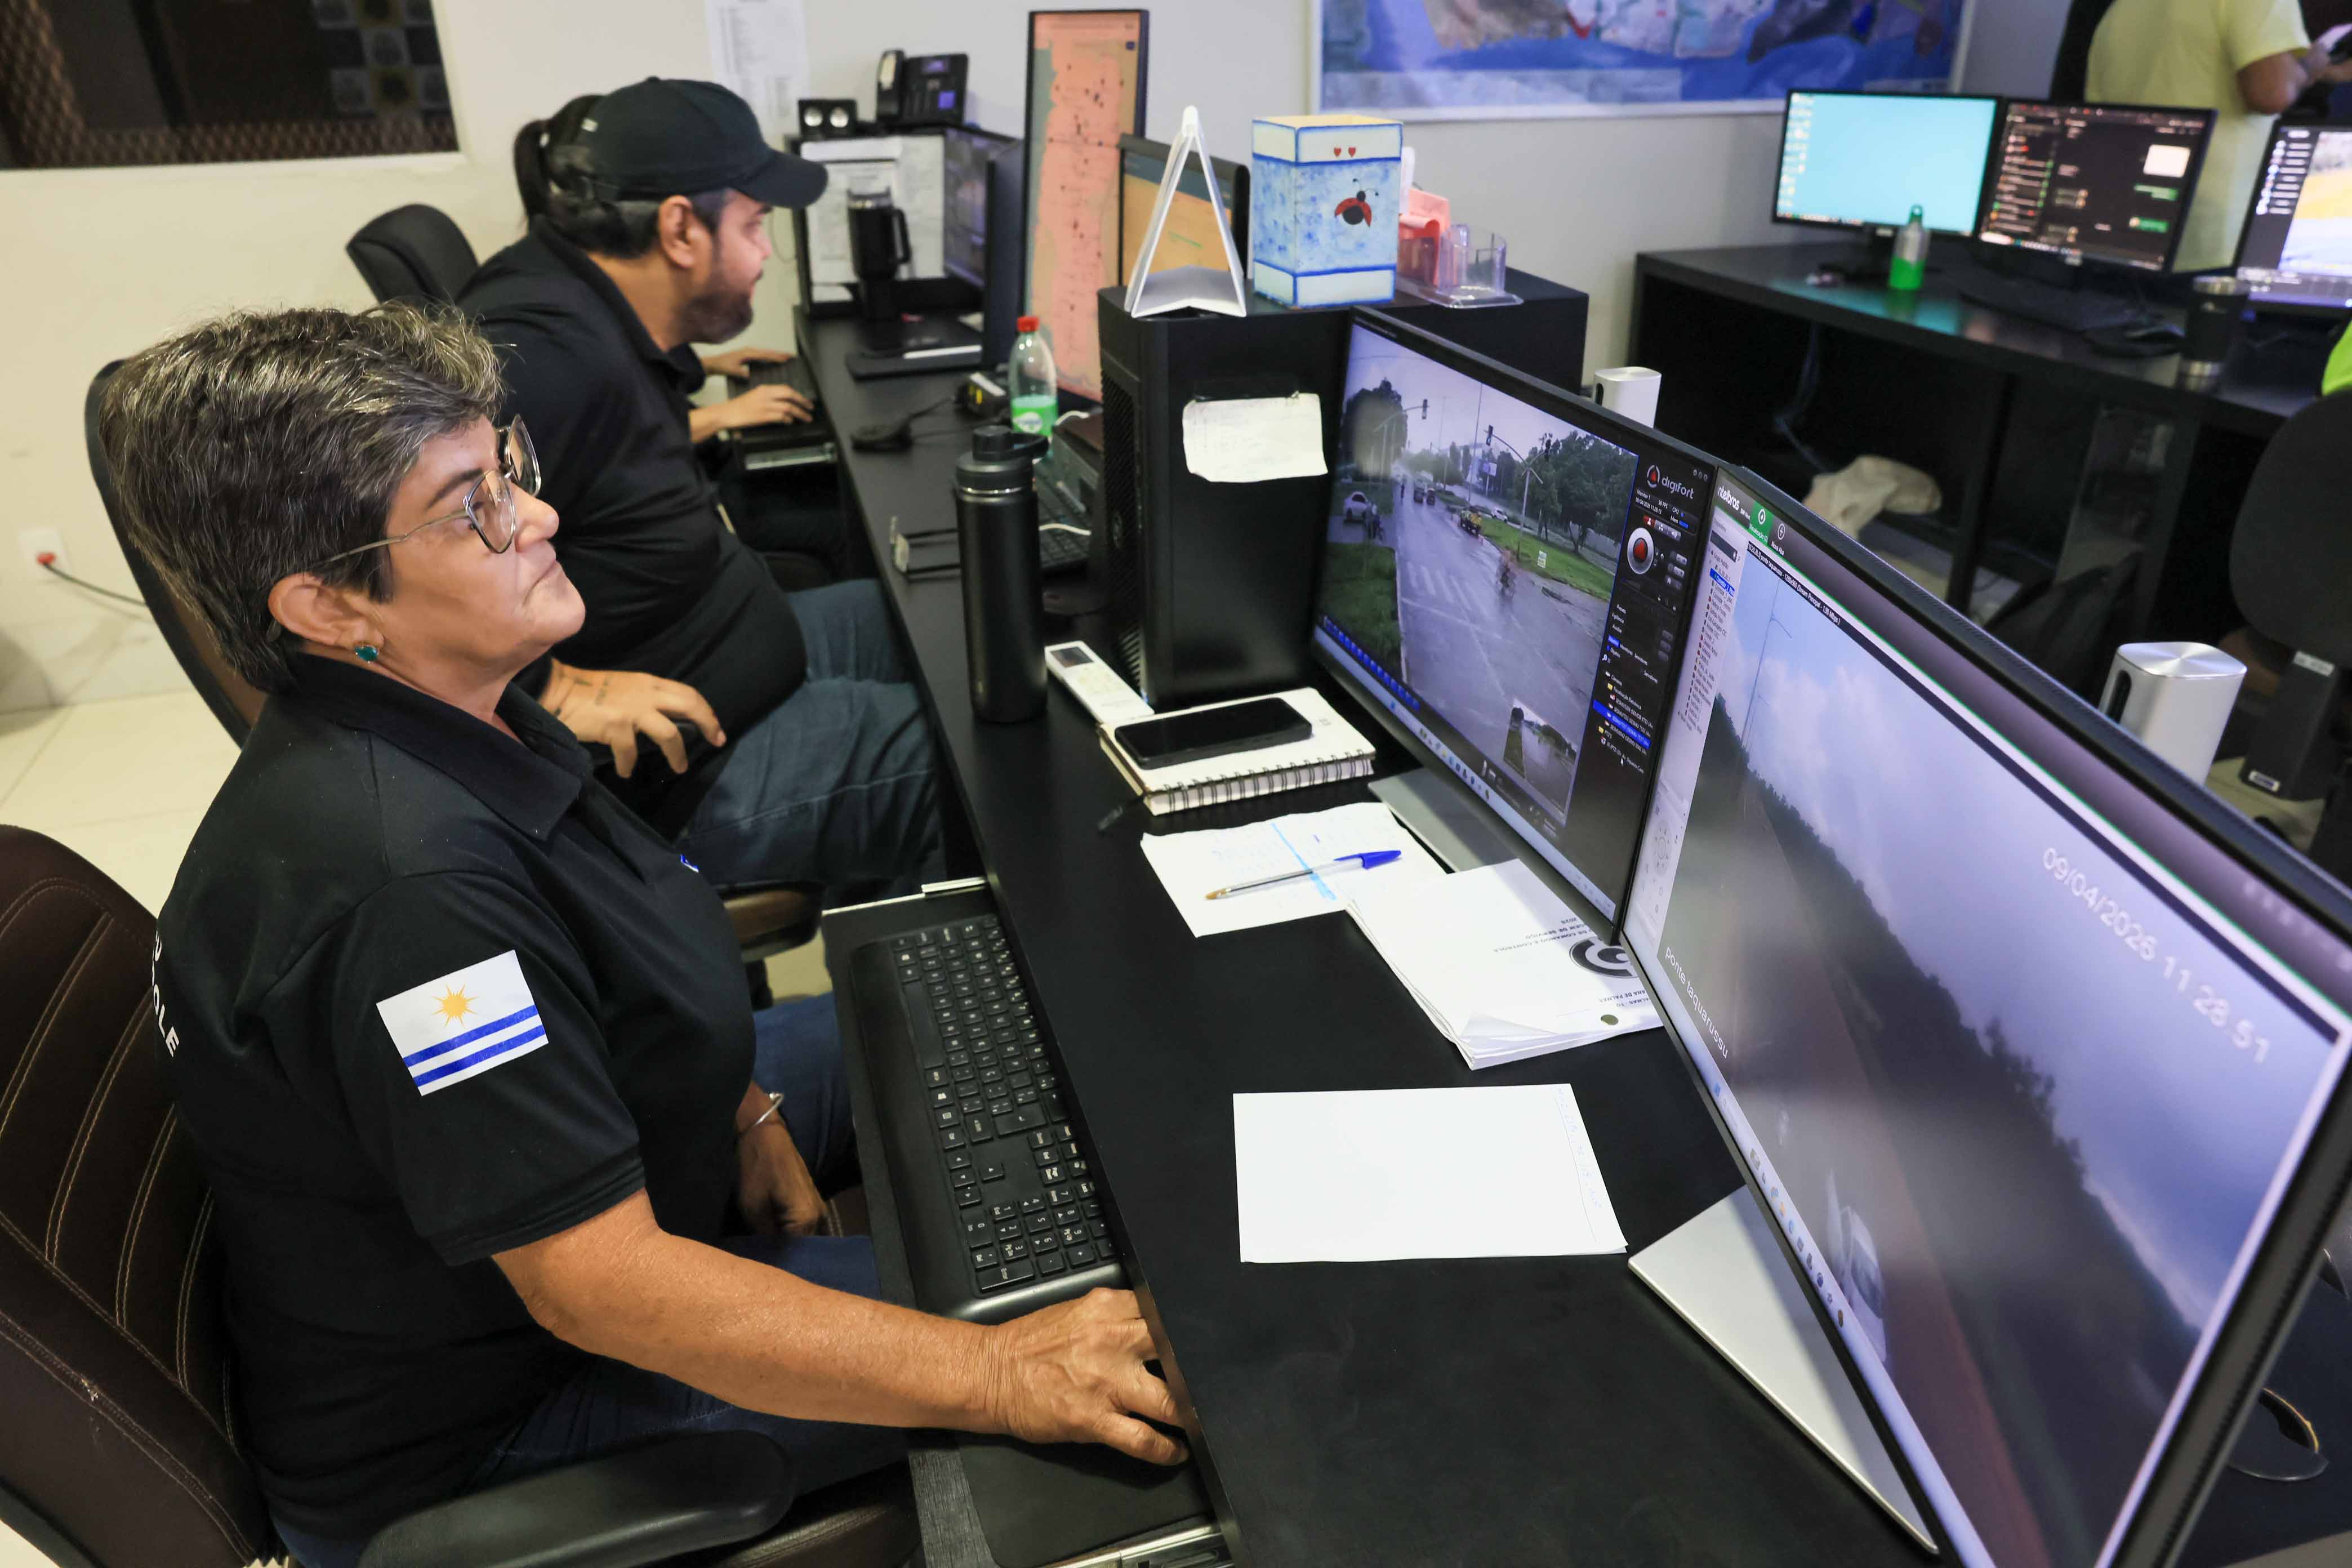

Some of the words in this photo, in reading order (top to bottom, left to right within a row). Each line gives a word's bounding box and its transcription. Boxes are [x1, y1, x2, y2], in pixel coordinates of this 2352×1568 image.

[1662, 475, 1694, 500] digifort
[1718, 486, 1739, 510] ntelbras
[2043, 847, 2159, 962] 09/04/2026
[1664, 946, 1686, 983] ponte
[1687, 980, 1729, 1059] taquarussu
